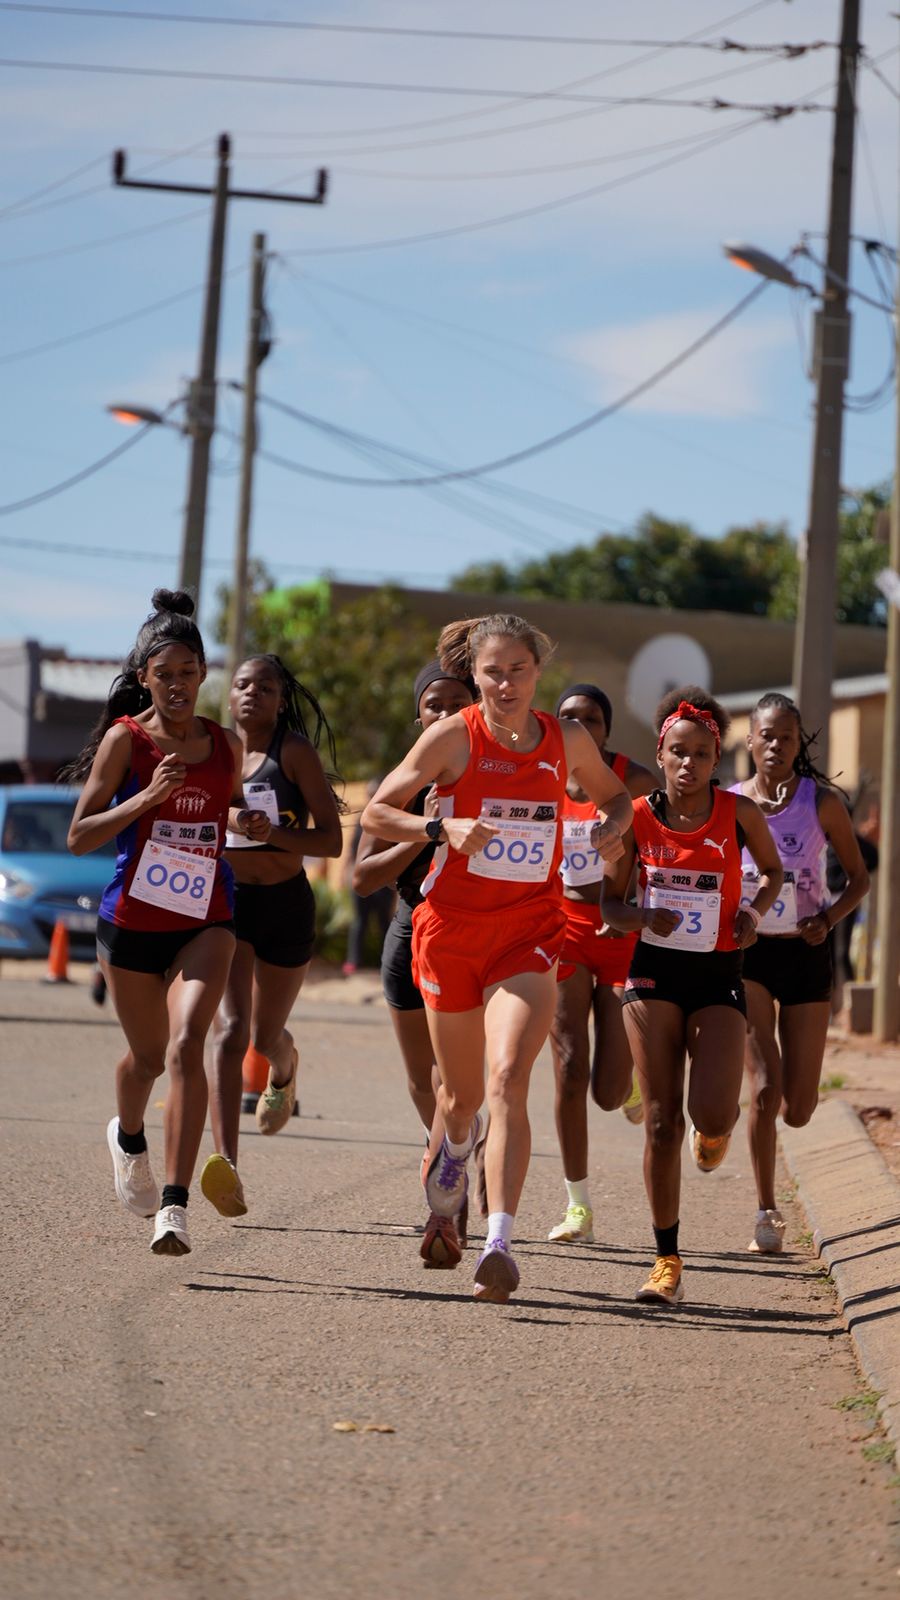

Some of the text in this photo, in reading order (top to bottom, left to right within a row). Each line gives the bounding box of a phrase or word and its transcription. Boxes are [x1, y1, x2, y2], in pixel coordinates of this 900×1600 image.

[509, 807, 529, 818] 2026
[536, 807, 553, 817] ASA
[179, 828, 196, 839] 2026
[483, 838, 544, 865] 005
[169, 858, 186, 868] STREET
[146, 864, 206, 899] 008
[671, 875, 691, 886] 2026
[701, 876, 716, 884] ASA
